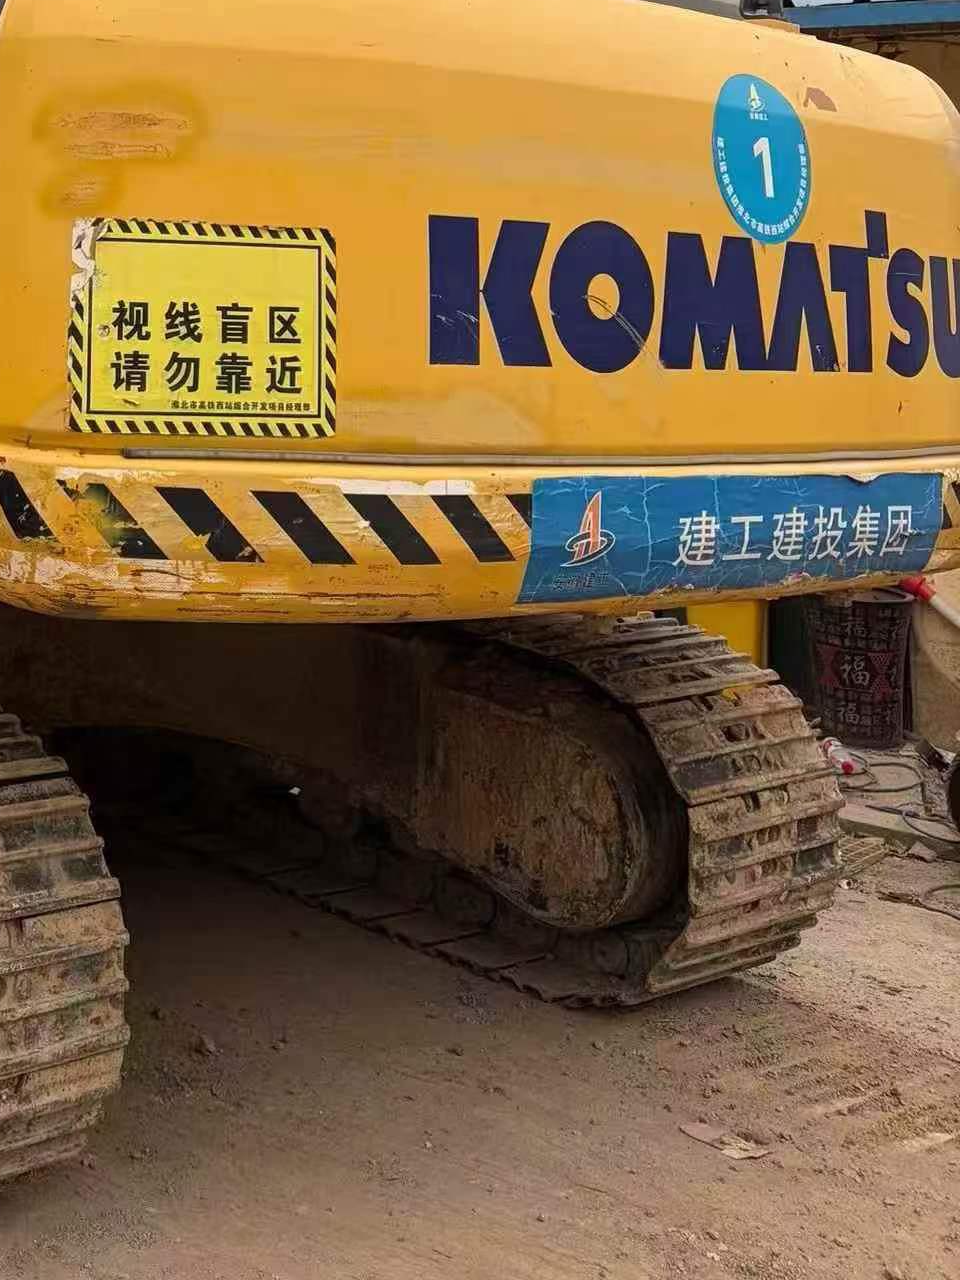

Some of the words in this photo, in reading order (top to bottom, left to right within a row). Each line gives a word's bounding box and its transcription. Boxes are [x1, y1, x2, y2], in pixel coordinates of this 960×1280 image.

[753, 137, 774, 198] 1
[428, 210, 960, 378] KOMATSU
[111, 300, 302, 344] 视线盲区
[111, 351, 302, 394] 请勿靠近
[673, 505, 913, 566] 建工建投集团
[843, 655, 870, 686] 福
